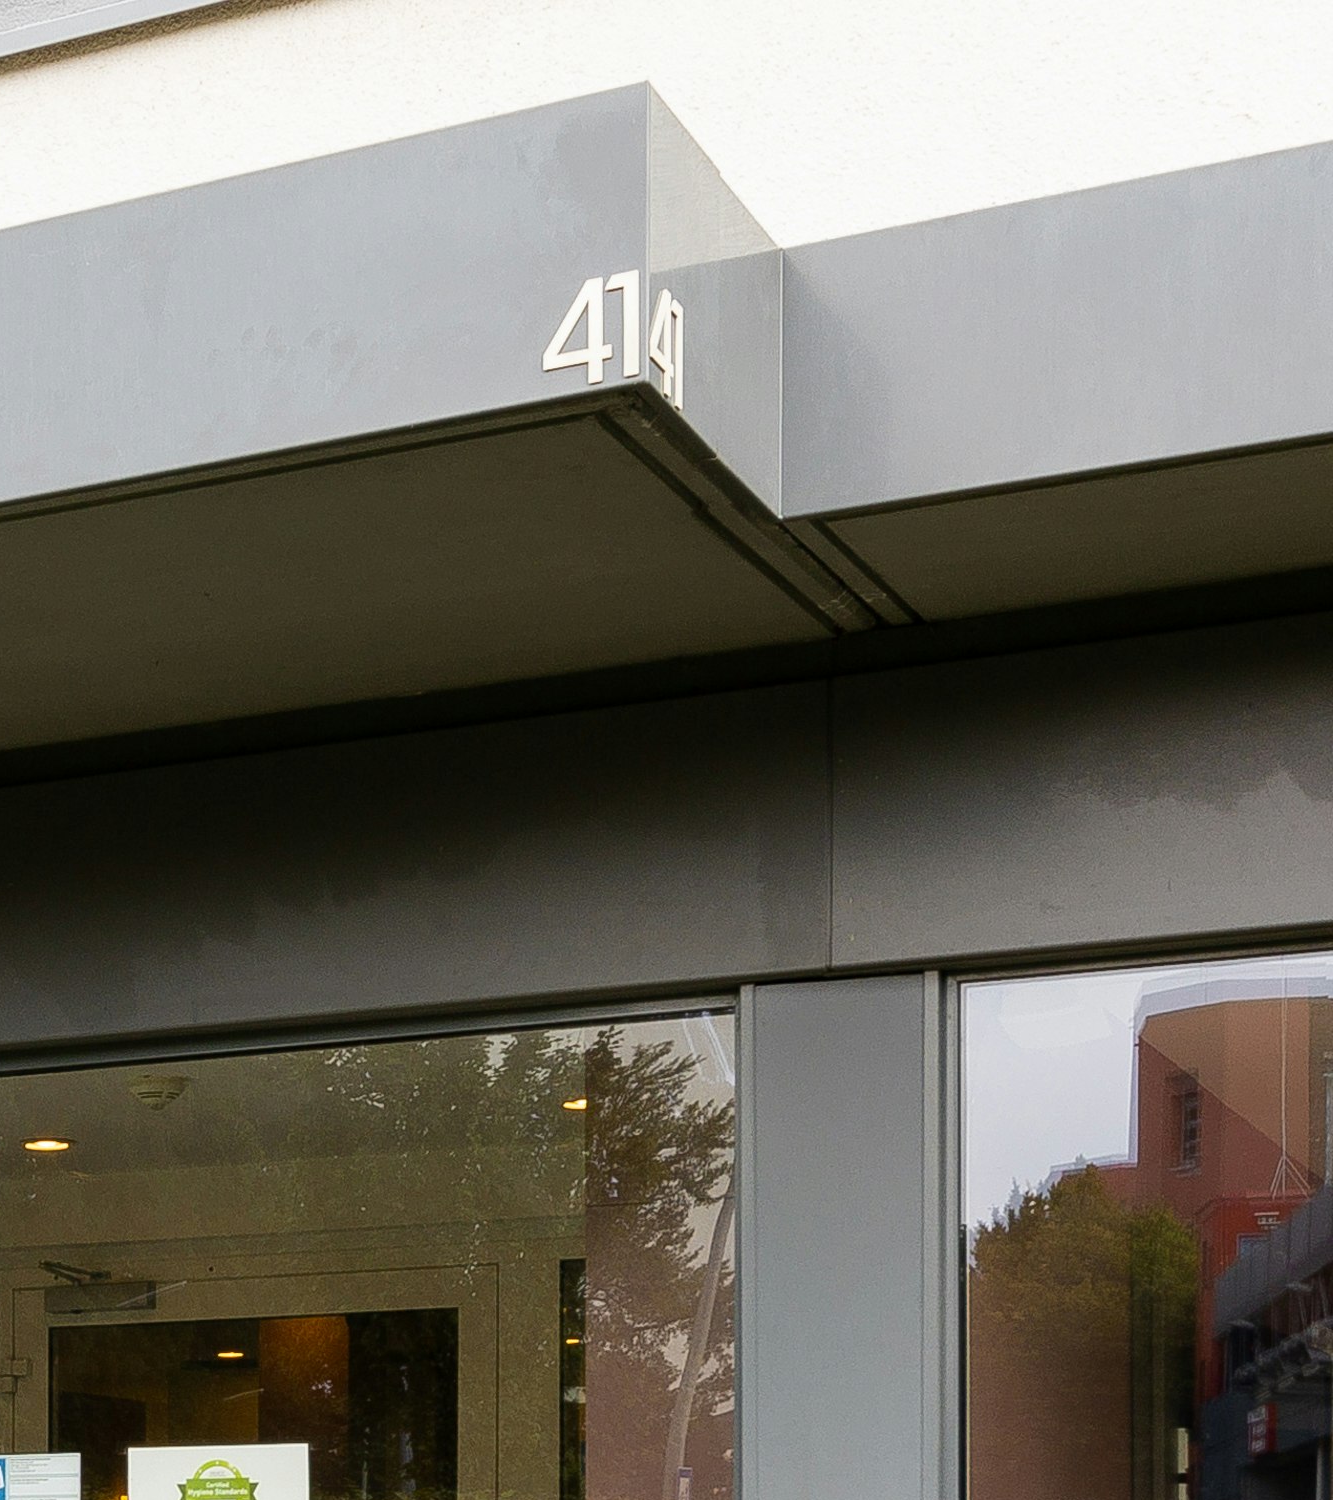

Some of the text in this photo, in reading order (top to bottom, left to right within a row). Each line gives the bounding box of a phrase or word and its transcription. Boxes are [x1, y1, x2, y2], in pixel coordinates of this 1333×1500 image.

[541, 269, 641, 386] 41
[649, 288, 685, 411] 41
[214, 1488, 248, 1496] Standards
